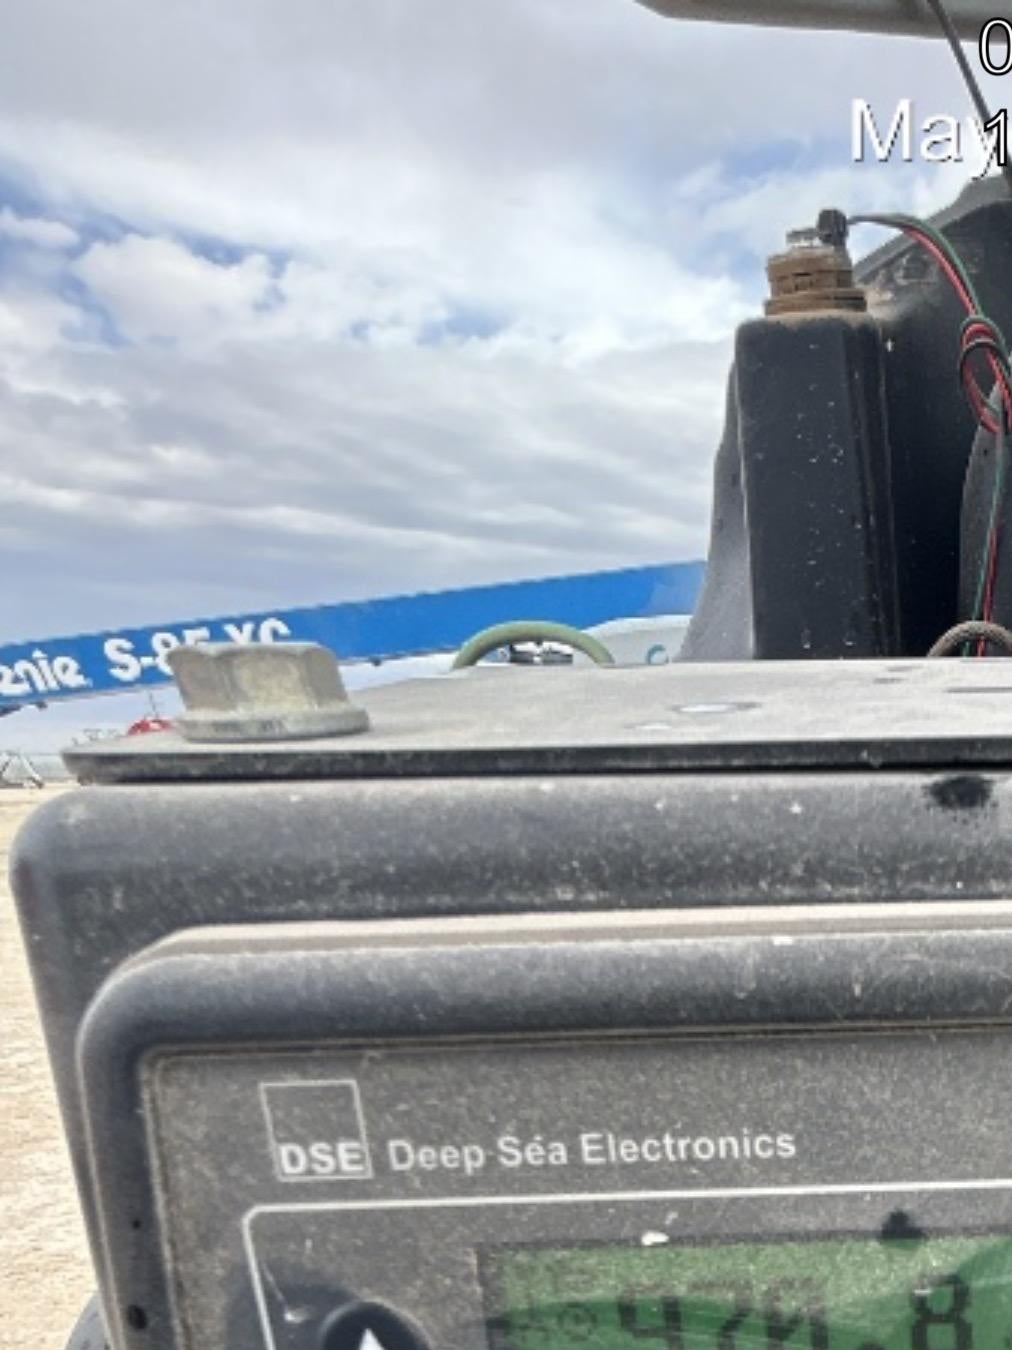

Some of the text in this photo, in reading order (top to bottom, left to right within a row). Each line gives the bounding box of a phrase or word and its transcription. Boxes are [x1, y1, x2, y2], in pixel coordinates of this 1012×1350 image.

[279, 1142, 365, 1175] DSE
[388, 1131, 797, 1176] Deep Sea Electronics
